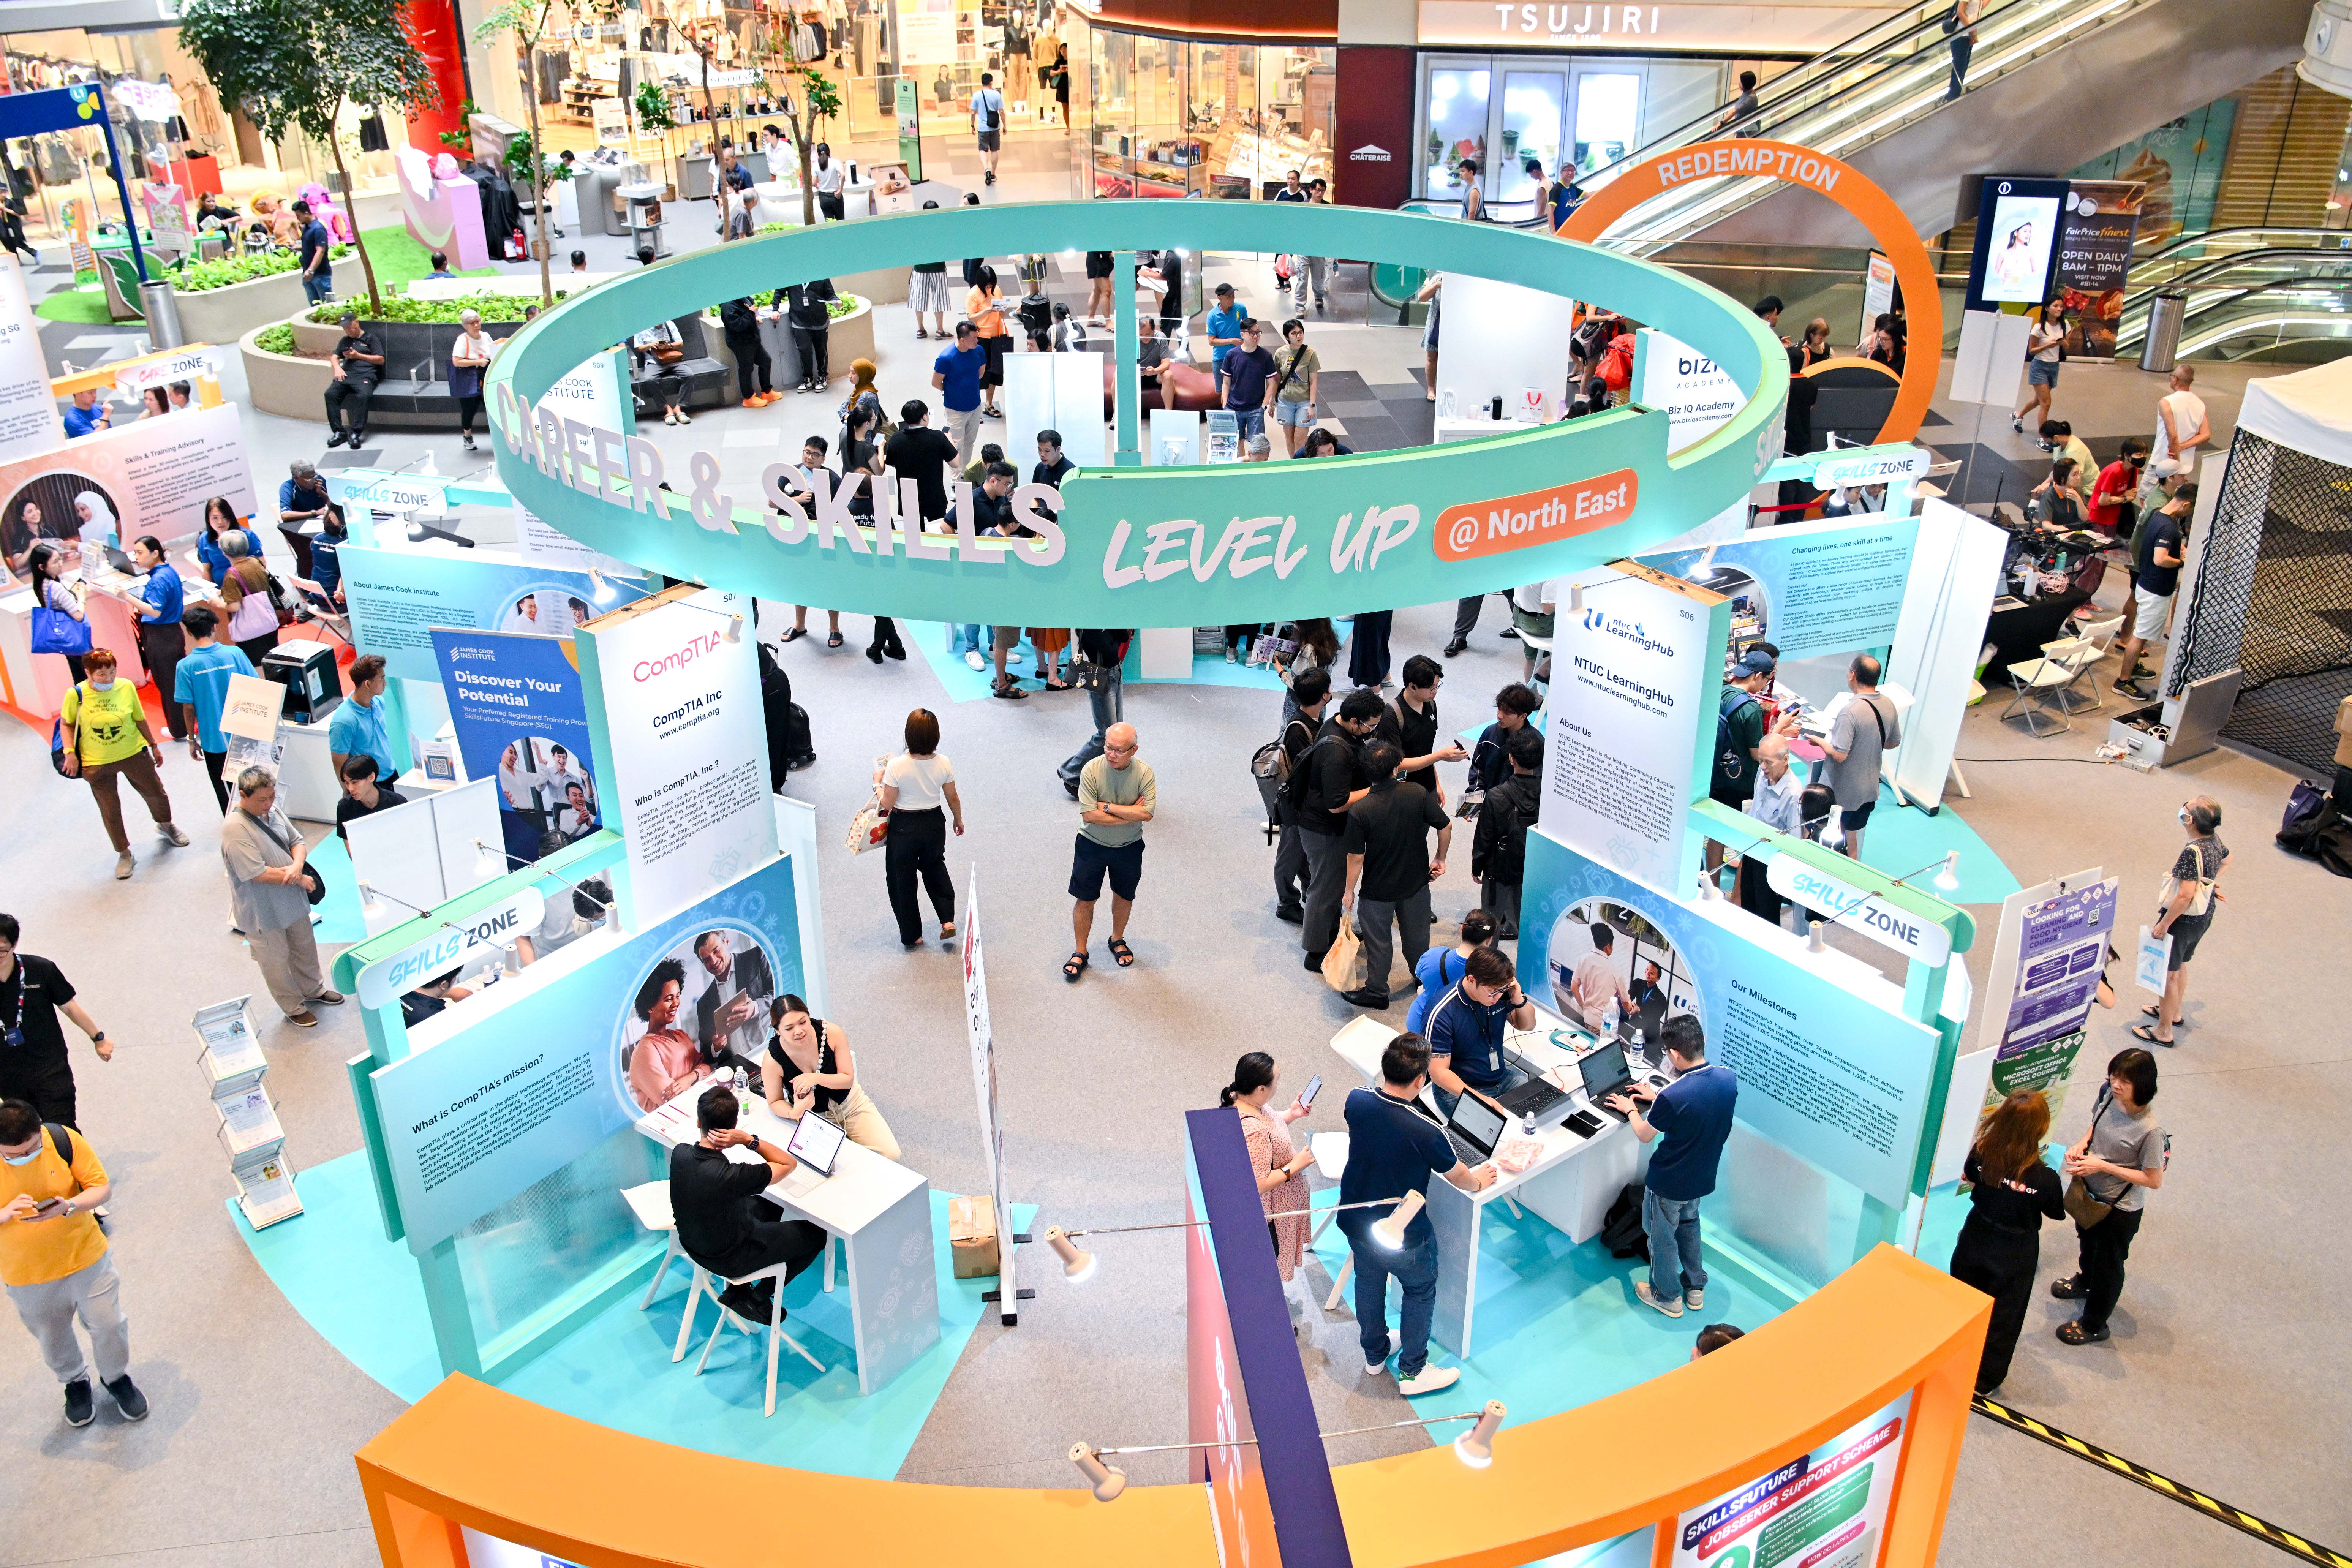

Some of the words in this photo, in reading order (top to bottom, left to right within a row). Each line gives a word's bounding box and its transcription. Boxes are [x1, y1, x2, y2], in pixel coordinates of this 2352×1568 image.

[1495, 4, 1660, 34] TSUJIRI
[1350, 153, 1391, 161] CHÂTERAISÉ
[1657, 149, 1840, 191] REDEMPTION
[2066, 227, 2099, 236] FairPrice
[2099, 226, 2130, 237] finest
[2062, 251, 2094, 260] OPEN
[2096, 252, 2128, 262] DAILY
[2062, 262, 2086, 271] 8AM
[2097, 263, 2121, 273] 11PM
[139, 365, 169, 382] CARE
[172, 357, 204, 374] ZONE
[547, 387, 594, 399] STITUTE
[566, 378, 593, 387] COOK
[1677, 378, 1731, 389] ACADEMY
[1668, 406, 1681, 415] Biz
[1684, 405, 1693, 413] IQ
[1696, 401, 1735, 412] Academy
[125, 455, 142, 464] Skills
[150, 446, 176, 457] Training
[178, 438, 204, 449] Advisory
[1832, 462, 1876, 482] SKILLS
[1879, 459, 1913, 475] ZONE
[344, 485, 389, 503] SKILLS
[392, 491, 429, 507] ZONE
[496, 383, 671, 521] CAREER
[690, 450, 739, 535] &
[762, 462, 1066, 566] SKILLS
[1103, 515, 1307, 589] LEVEL
[1330, 504, 1420, 573] UP
[1448, 516, 1479, 553] @
[1488, 496, 1566, 539] North
[1574, 482, 1627, 521] East
[1792, 545, 1821, 555] Changing
[414, 588, 439, 597] Institute
[1680, 610, 1694, 621] S06
[1606, 622, 1674, 657] LearningHub
[460, 653, 496, 661] INSTITUTE
[634, 630, 720, 682] CompTIA
[455, 671, 522, 688] Discover
[525, 678, 562, 693] Your
[1574, 656, 1604, 677] NTUC
[1607, 669, 1674, 707] LearningHub
[458, 688, 529, 707] Potential
[1578, 675, 1667, 718] www.ntuclearninghub.com
[240, 707, 268, 717] INSTITUTE
[479, 708, 507, 716] Preferred
[508, 712, 542, 721] Registered
[544, 716, 569, 725] Training
[653, 697, 703, 727] CompTIA
[706, 690, 722, 704] Inc
[465, 713, 500, 722] SkillsFuture
[501, 718, 533, 727] Singapore
[659, 708, 719, 740] www.comptia.org
[1560, 718, 1581, 733] About
[1582, 727, 1592, 738] Us
[1558, 733, 1570, 741] NTUC
[1572, 739, 1597, 754] LearningHub
[1613, 757, 1628, 769] leading
[1630, 765, 1652, 780] Continuing
[1654, 776, 1675, 790] Education
[635, 794, 652, 806] Who
[663, 771, 700, 793] CompTIA,
[702, 760, 719, 775] Inc.?
[637, 807, 658, 820] CompTIA
[677, 789, 697, 801] students,
[700, 773, 729, 790] professionals,
[743, 759, 756, 768] career
[1791, 873, 1861, 916] SKILLS
[1864, 906, 1920, 946] ZONE
[2031, 909, 2064, 925] LOOKING
[2065, 904, 2080, 912] FOR
[2030, 931, 2050, 941] FOOD
[2052, 918, 2083, 933] HYGIENE
[2031, 917, 2066, 933] CLEANING
[2068, 911, 2084, 921] AND
[389, 933, 461, 987] SKILLS
[464, 907, 519, 947] ZONE
[2029, 933, 2062, 948] COURSE?
[2070, 942, 2087, 950] COURSES
[1731, 979, 1747, 993] Our
[1749, 988, 1797, 1020] Milestones
[2036, 989, 2058, 1000] CLEANING
[2059, 982, 2078, 991] COURSES
[2003, 1065, 2043, 1081] MICROSOFT
[2044, 1057, 2067, 1069] OFFICE
[2030, 1054, 2060, 1066] INTERMEDIATE
[2009, 1075, 2031, 1086] EXCEL
[2032, 1066, 2058, 1078] COURSE
[412, 1116, 438, 1134] What
[440, 1109, 449, 1119] is
[450, 1079, 501, 1113] CompTIA's
[503, 1054, 544, 1083] mission?
[1705, 1497, 1777, 1549] JOBSEEKER
[1781, 1460, 1840, 1501] SUPPORT
[1841, 1425, 1892, 1464] SCHEME
[1687, 1463, 1797, 1541] SKILLSFUTURE
[1766, 1518, 1787, 1534] Financial
[1788, 1506, 1807, 1519] Support
[1813, 1492, 1829, 1504] $6,000
[1837, 1468, 1868, 1490] Singaporeans
[1807, 1554, 1822, 1564] HOW
[1835, 1530, 1856, 1546] APPLY?
